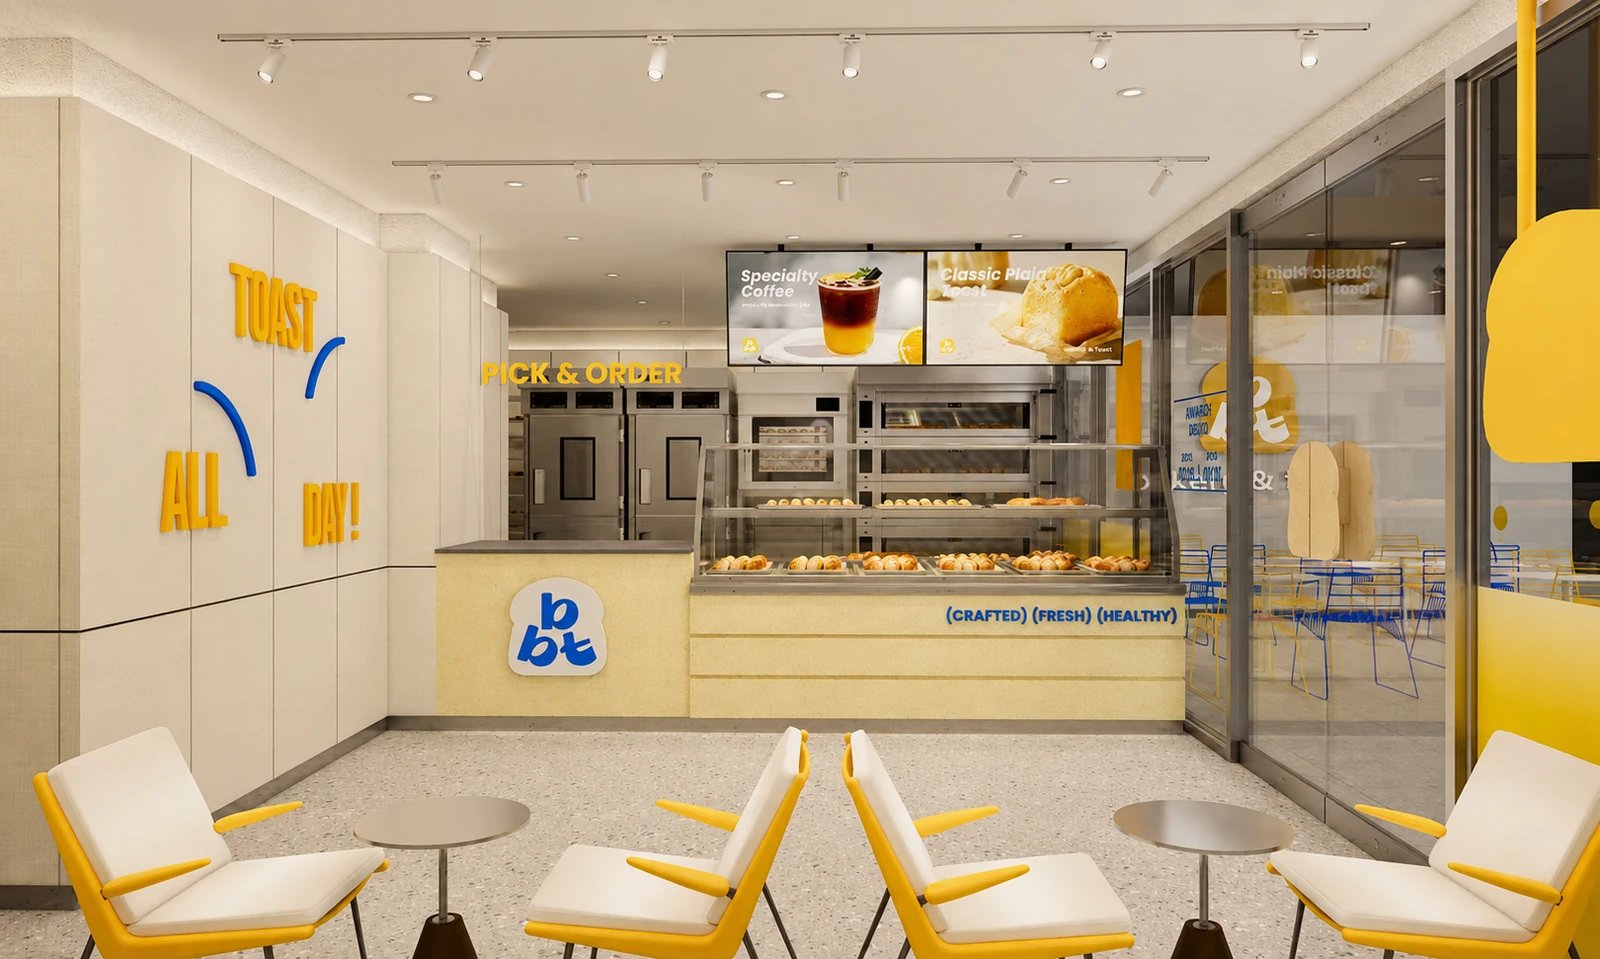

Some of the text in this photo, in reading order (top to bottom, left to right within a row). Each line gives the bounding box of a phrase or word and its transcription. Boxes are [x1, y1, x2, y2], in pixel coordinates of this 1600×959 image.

[741, 268, 818, 286] Specialty
[940, 266, 1001, 281] Classic
[741, 284, 794, 297] Coffee
[229, 262, 318, 352] TOAST
[482, 362, 682, 385] PICK & ORDER
[160, 451, 228, 532] ALL
[303, 482, 360, 547] DAY!
[946, 606, 1177, 625] (CRAFTED) (FRESH) (HEALTHY)
